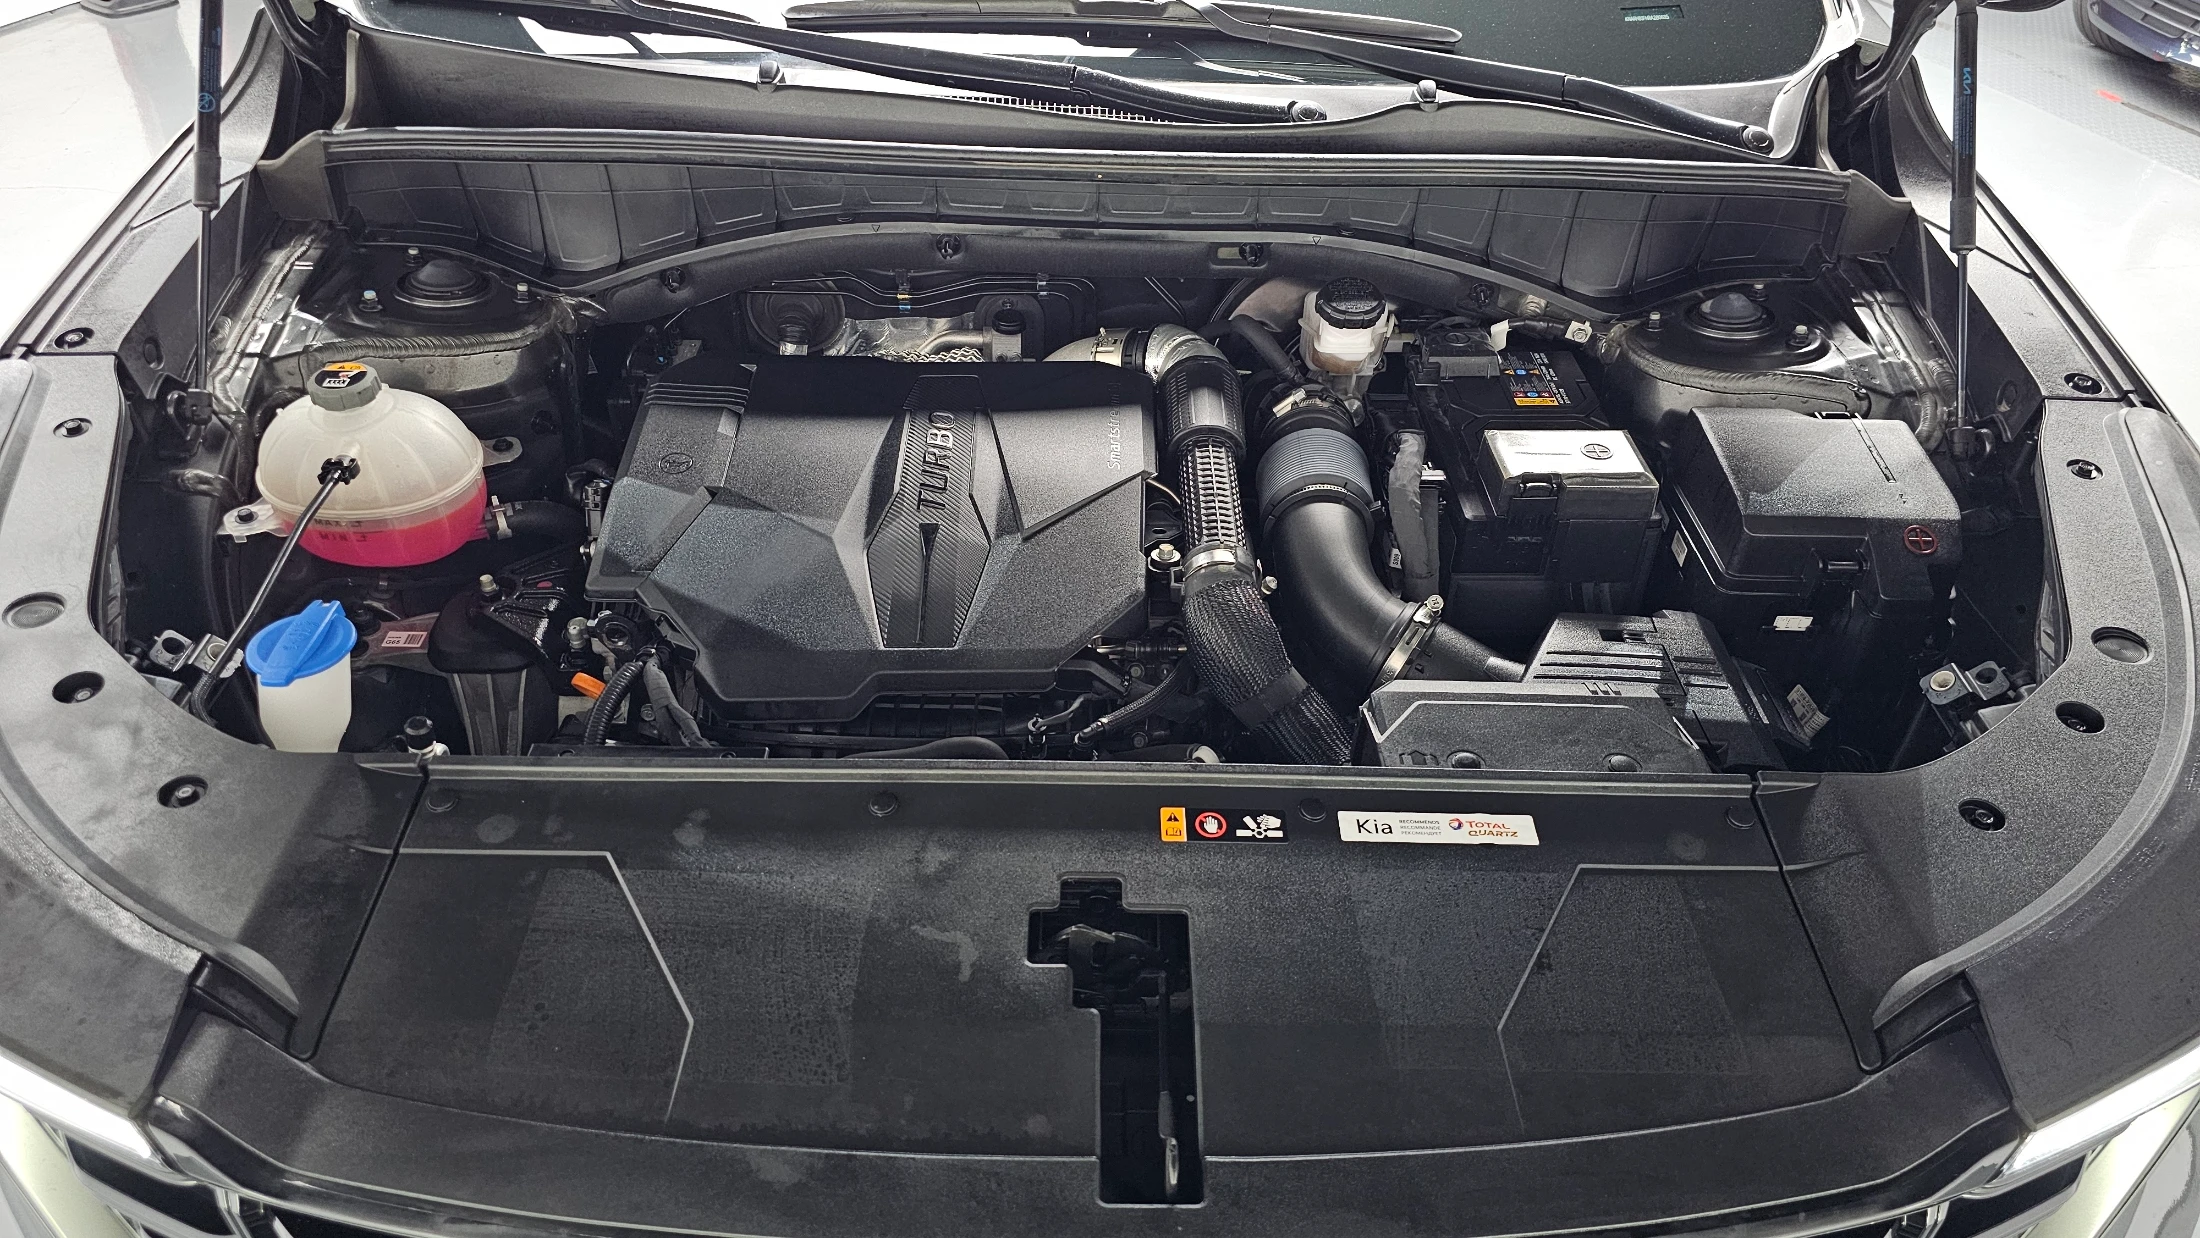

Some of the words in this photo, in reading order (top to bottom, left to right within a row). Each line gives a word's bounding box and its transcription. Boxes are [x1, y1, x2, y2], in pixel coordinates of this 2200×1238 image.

[916, 410, 956, 511] TURBO
[1356, 818, 1393, 835] Kia
[1466, 820, 1510, 829] TOTAL
[1468, 829, 1519, 838] QUARTZ
